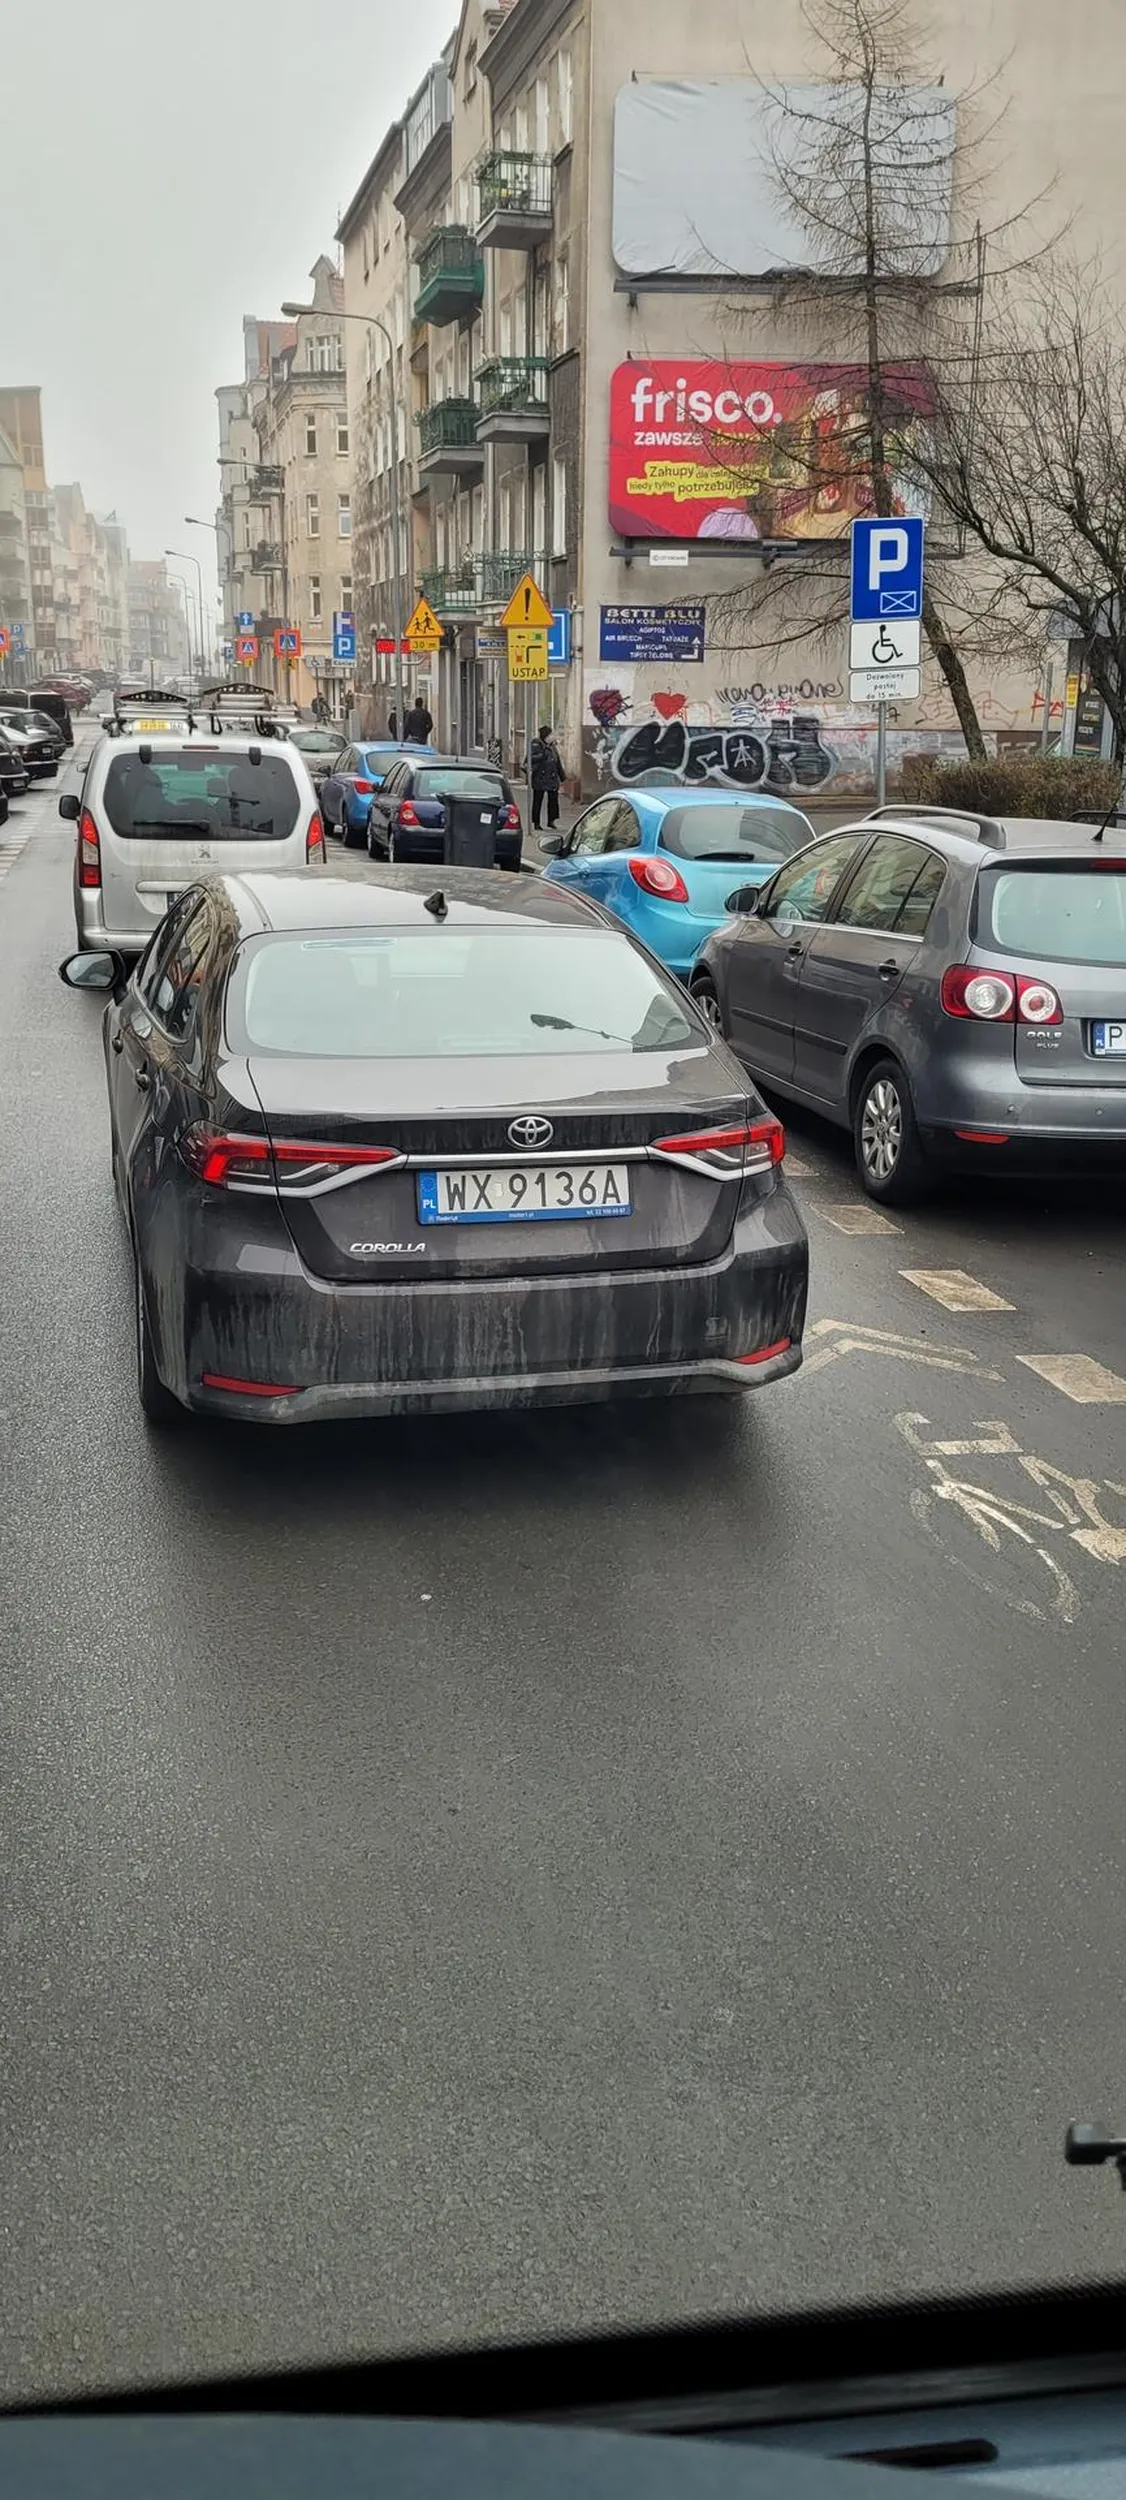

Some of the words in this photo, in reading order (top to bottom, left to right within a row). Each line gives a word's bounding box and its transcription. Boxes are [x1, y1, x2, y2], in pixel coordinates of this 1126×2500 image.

[631, 378, 783, 424] frisco.
[634, 432, 704, 446] zawsze
[869, 528, 908, 590] P
[607, 608, 656, 618] BETTI
[664, 609, 700, 618] BLU
[637, 618, 700, 626] KOSMETYCZNY
[339, 637, 351, 656] P
[1109, 1026, 1122, 1047] P
[445, 1174, 493, 1211] WX
[508, 1169, 621, 1208] 9136A
[423, 1200, 436, 1209] PL
[350, 1242, 426, 1253] COROLLA
